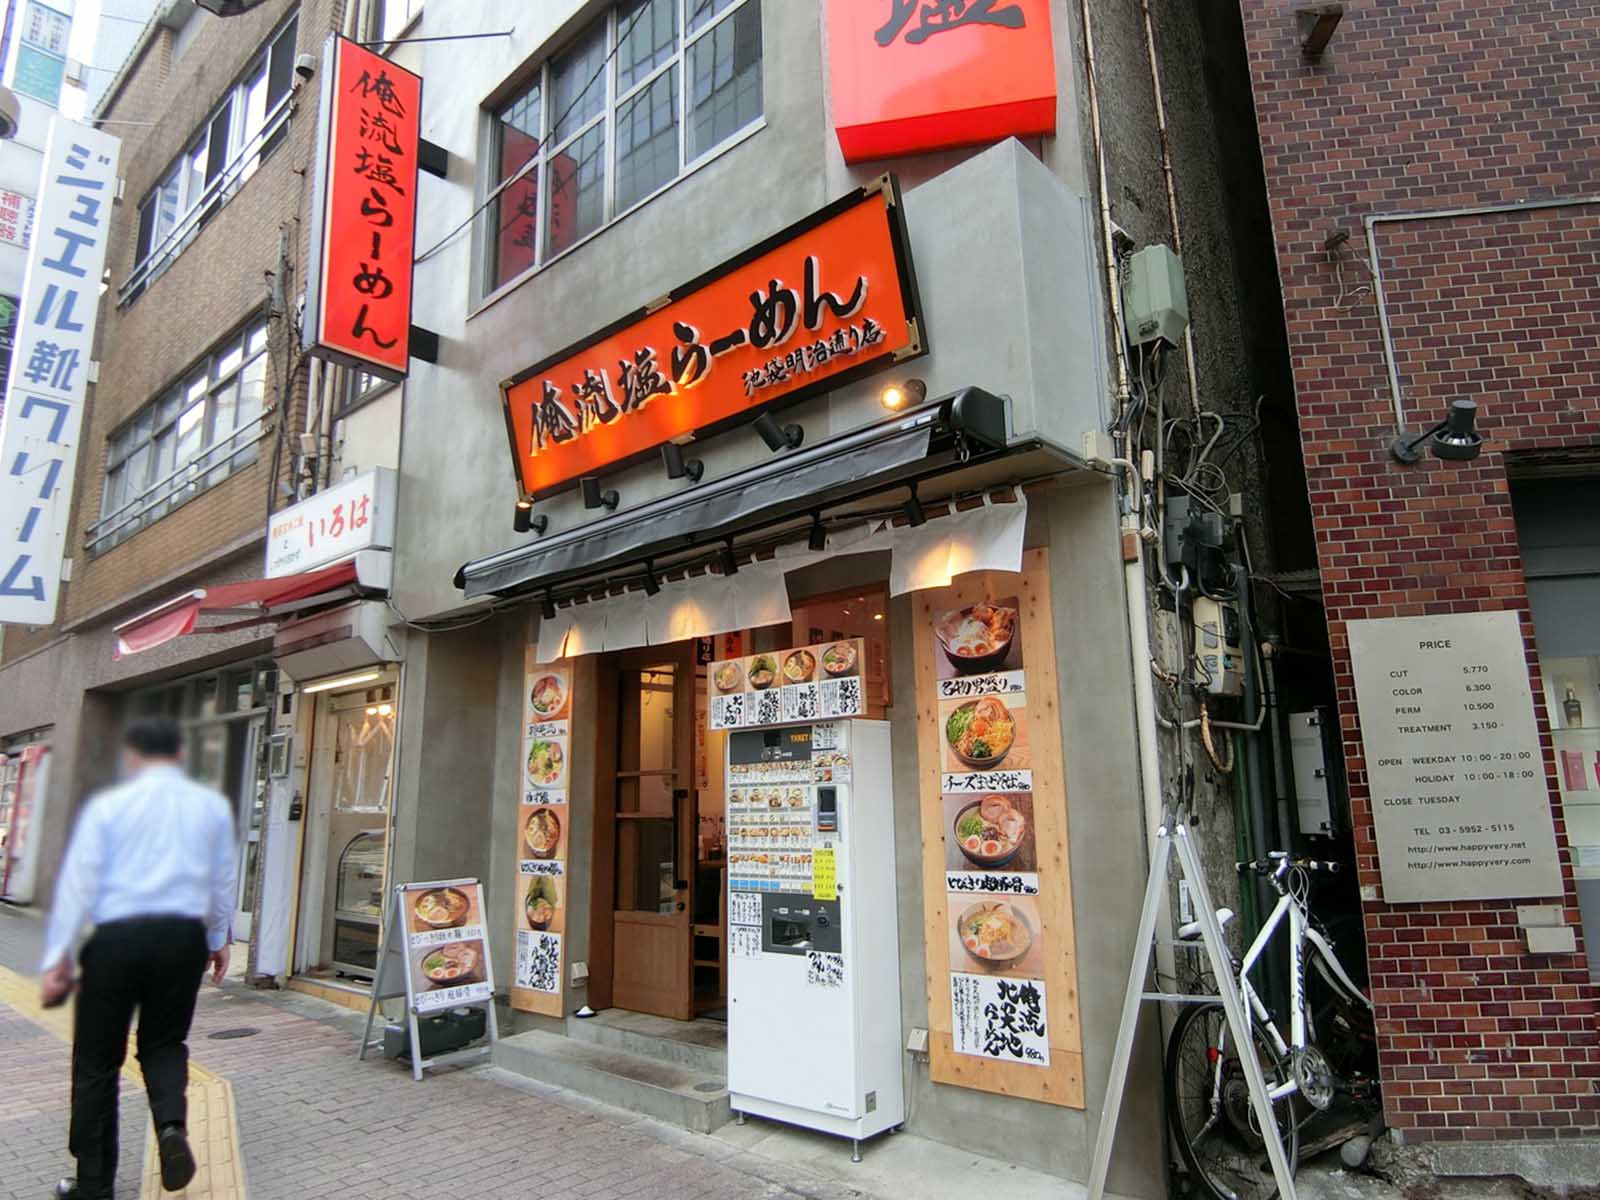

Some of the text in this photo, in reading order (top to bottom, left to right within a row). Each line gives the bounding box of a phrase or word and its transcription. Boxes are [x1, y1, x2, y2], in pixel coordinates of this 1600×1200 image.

[350, 70, 405, 349] 俺流塩らーめん
[530, 255, 868, 456] 俺流塩らーめん
[742, 317, 886, 397] 池袋明治通り店
[0, 143, 110, 602] ジュエル靴クリーム
[308, 494, 370, 548] いろは
[1419, 640, 1451, 650] PRICE
[1390, 670, 1408, 678] CUT
[1392, 687, 1423, 696] COLOR
[1395, 706, 1421, 714] PERM
[1398, 724, 1452, 733] TREATMENT
[1378, 758, 1402, 766] OPEN
[1412, 755, 1456, 765] WEEKDAY
[1415, 774, 1455, 784] HOLIDAY
[1384, 795, 1461, 806] CLOSE TUESDAY
[1413, 827, 1430, 836] TEL
[1408, 840, 1526, 854] http://www.happyvery.net
[1408, 856, 1531, 870] http://www.happyvery.com
[1296, 944, 1305, 1014] GIANT
